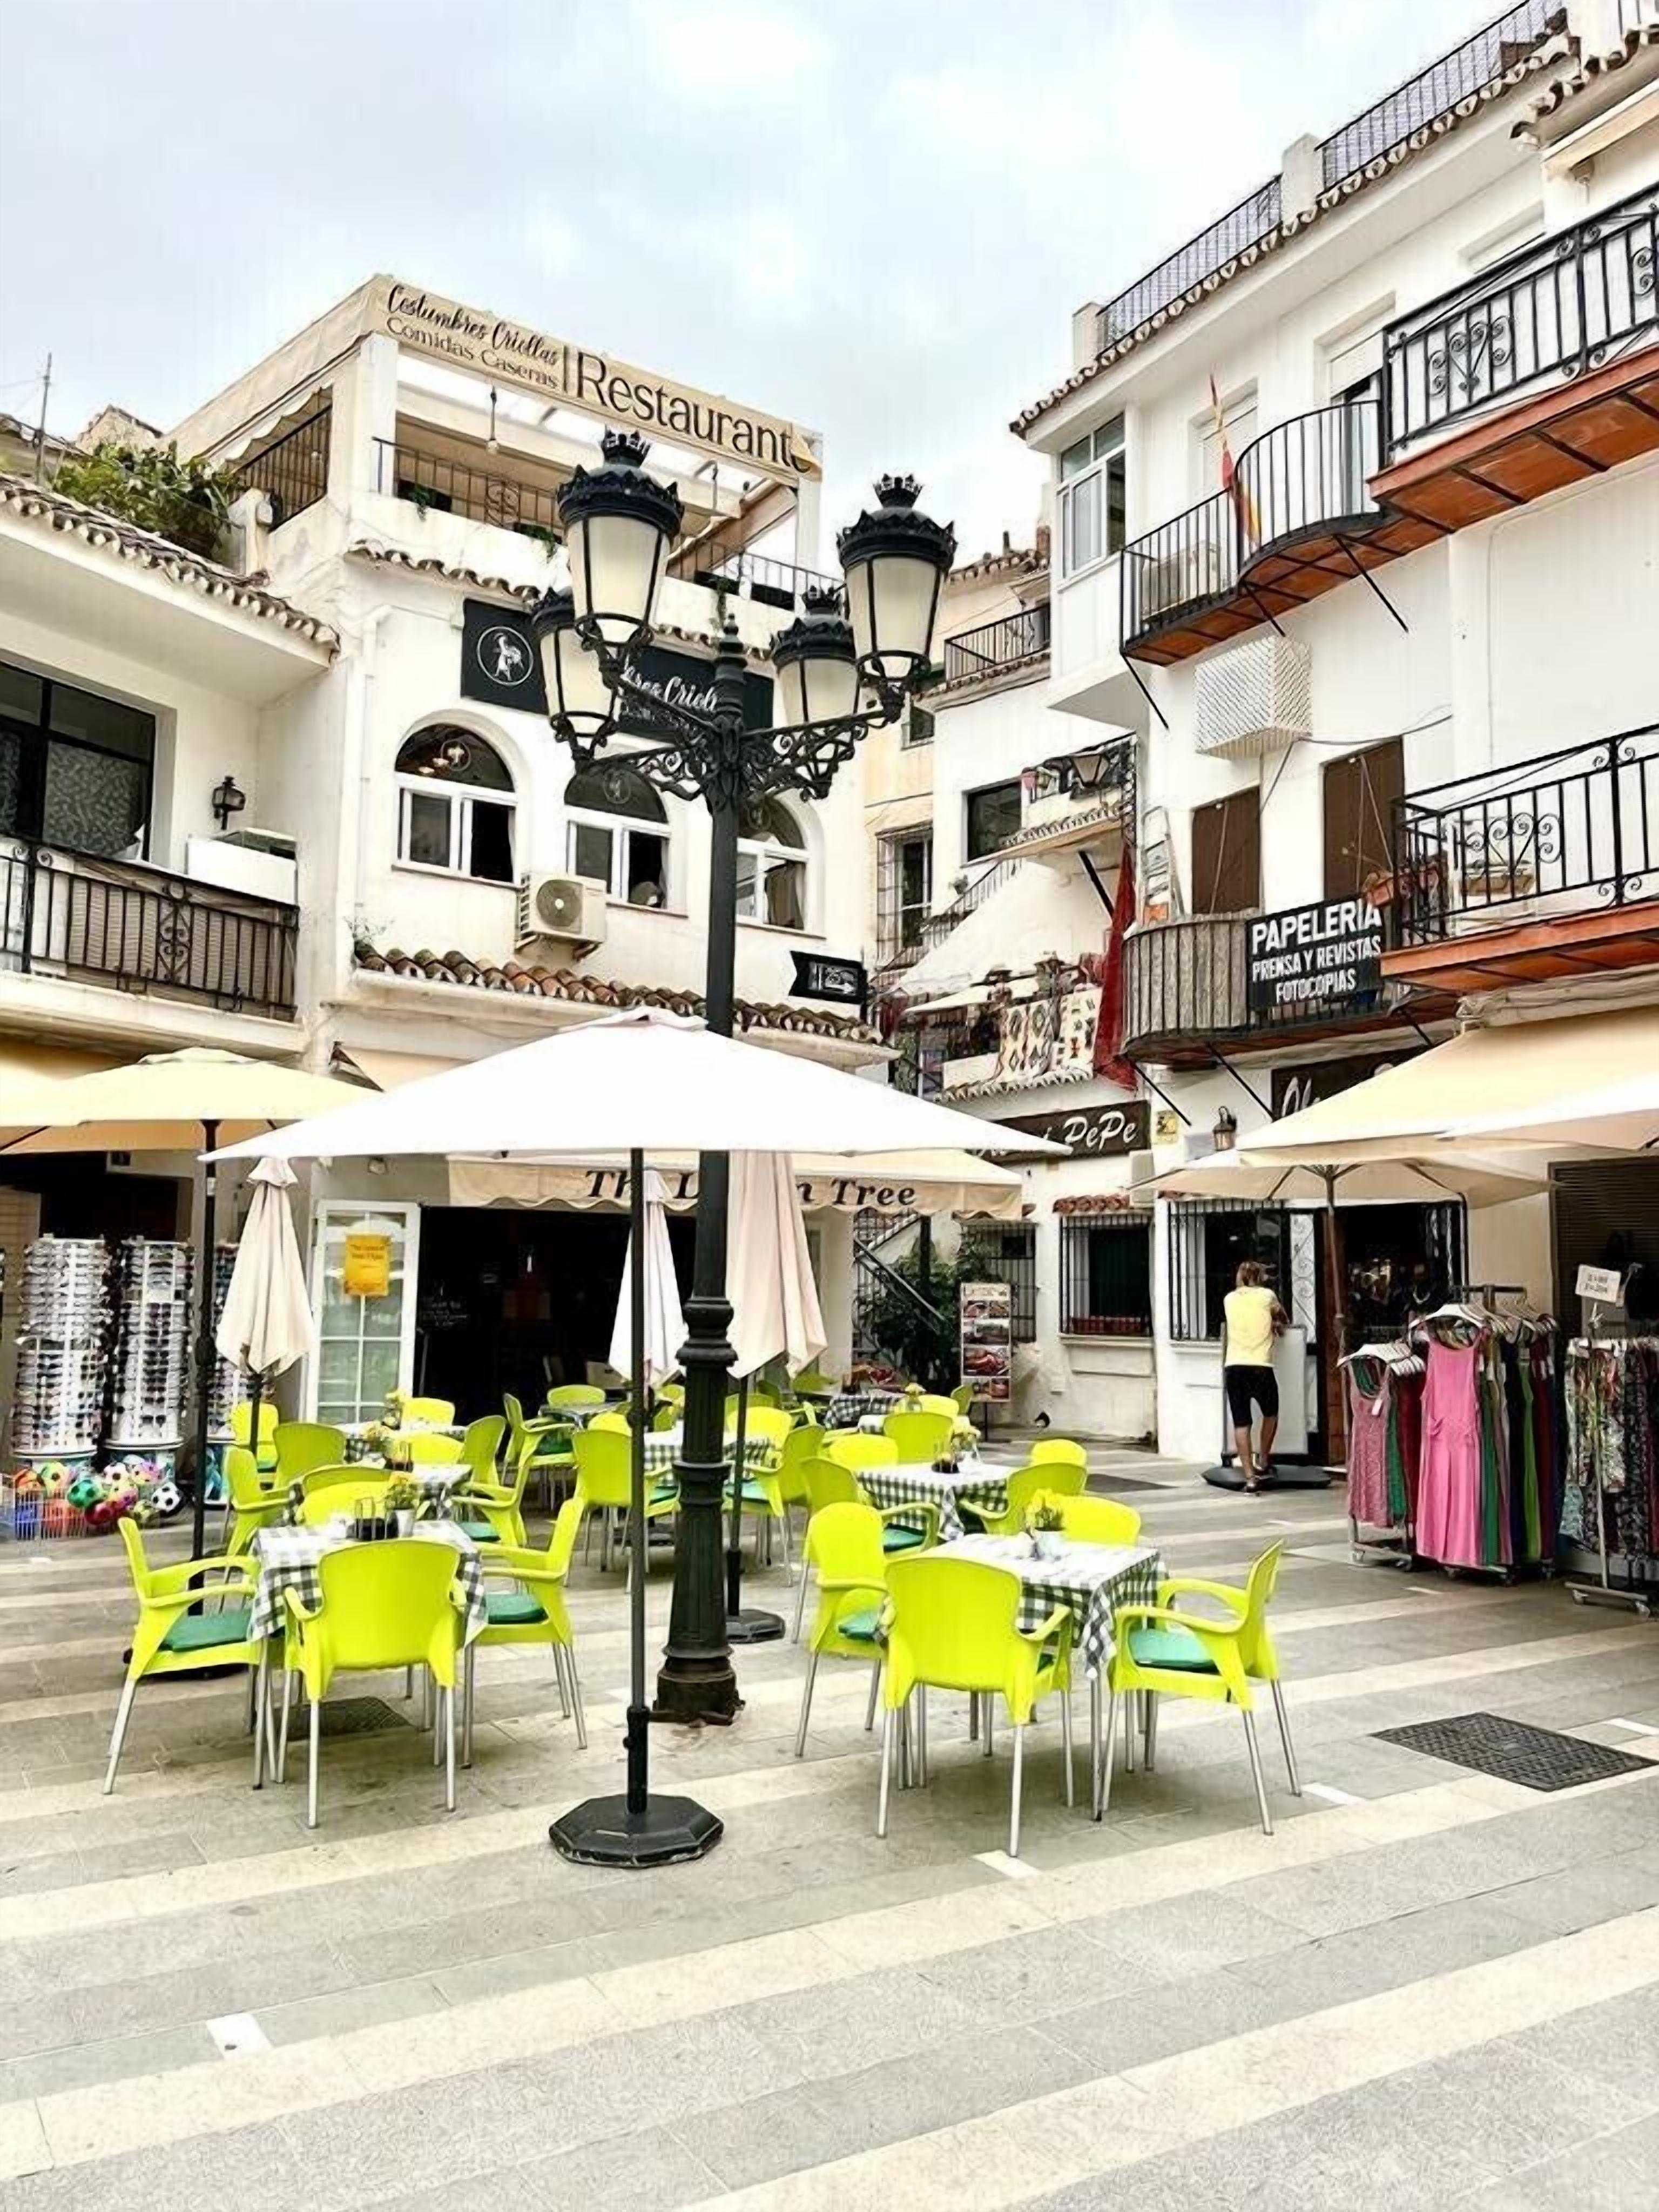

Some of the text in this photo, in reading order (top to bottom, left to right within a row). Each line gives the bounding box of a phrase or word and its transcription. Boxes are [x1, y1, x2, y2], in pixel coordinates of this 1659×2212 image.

[387, 317, 558, 389] Comidas Caseras
[1252, 898, 1382, 955] PAPELERIA
[1252, 935, 1381, 982] PRENSA Y REVISTAS
[1276, 968, 1357, 1003] FOTOCOPIAS
[831, 1177, 917, 1205] Tree
